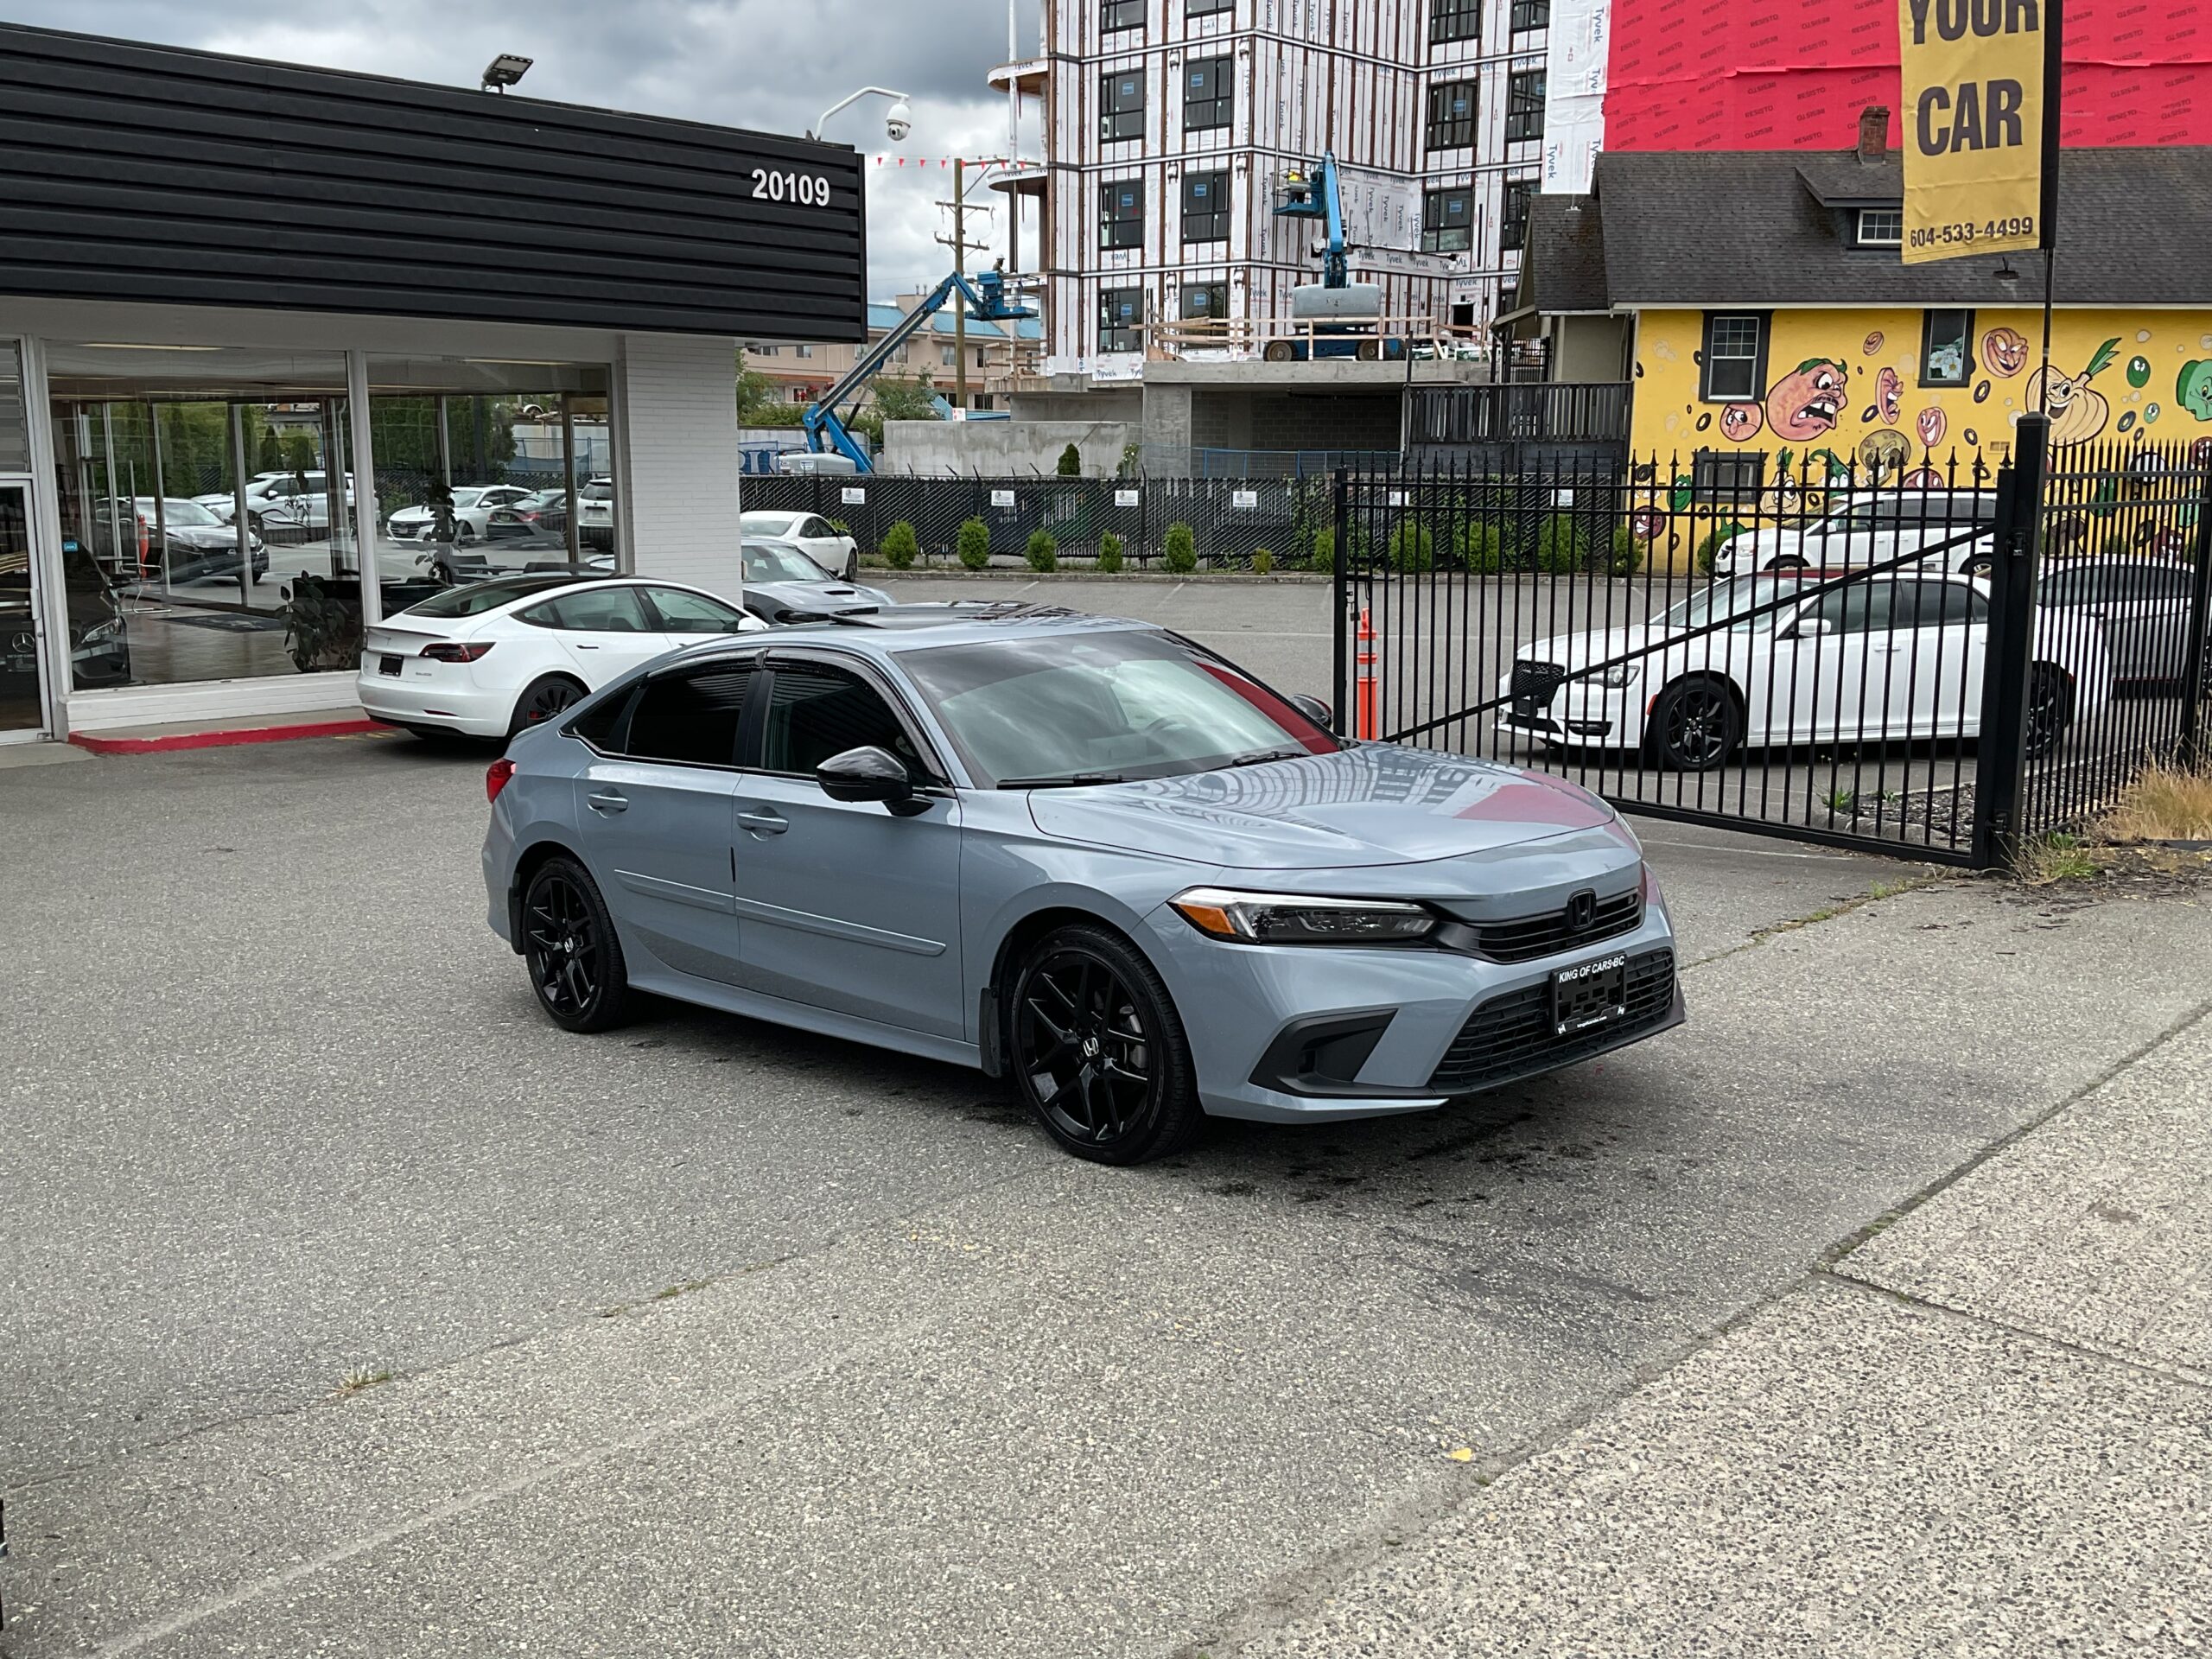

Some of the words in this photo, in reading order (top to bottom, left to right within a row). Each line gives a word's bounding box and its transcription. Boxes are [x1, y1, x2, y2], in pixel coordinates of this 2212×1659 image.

[1592, 7, 1605, 43] Tyvek
[1750, 14, 1779, 28] RESISTO
[1852, 21, 1880, 34] RESISTO
[1798, 40, 1827, 54] RESISTO
[1433, 68, 1457, 78] Tyvek
[1797, 87, 1826, 99] RESISTO
[1847, 95, 1877, 108] RESISTO
[1745, 105, 1774, 118] RESISTO
[1916, 79, 2023, 156] CAR
[1794, 131, 1822, 144] RESISTO
[1547, 143, 1558, 180] Tyvek
[752, 168, 830, 207] 20109
[1910, 216, 2033, 248] 604-533-4499
[1386, 254, 1402, 264] Tyvek
[1096, 369, 1117, 378] Tyvek
[1559, 969, 1578, 983] KING
[1580, 965, 1591, 977] OF
